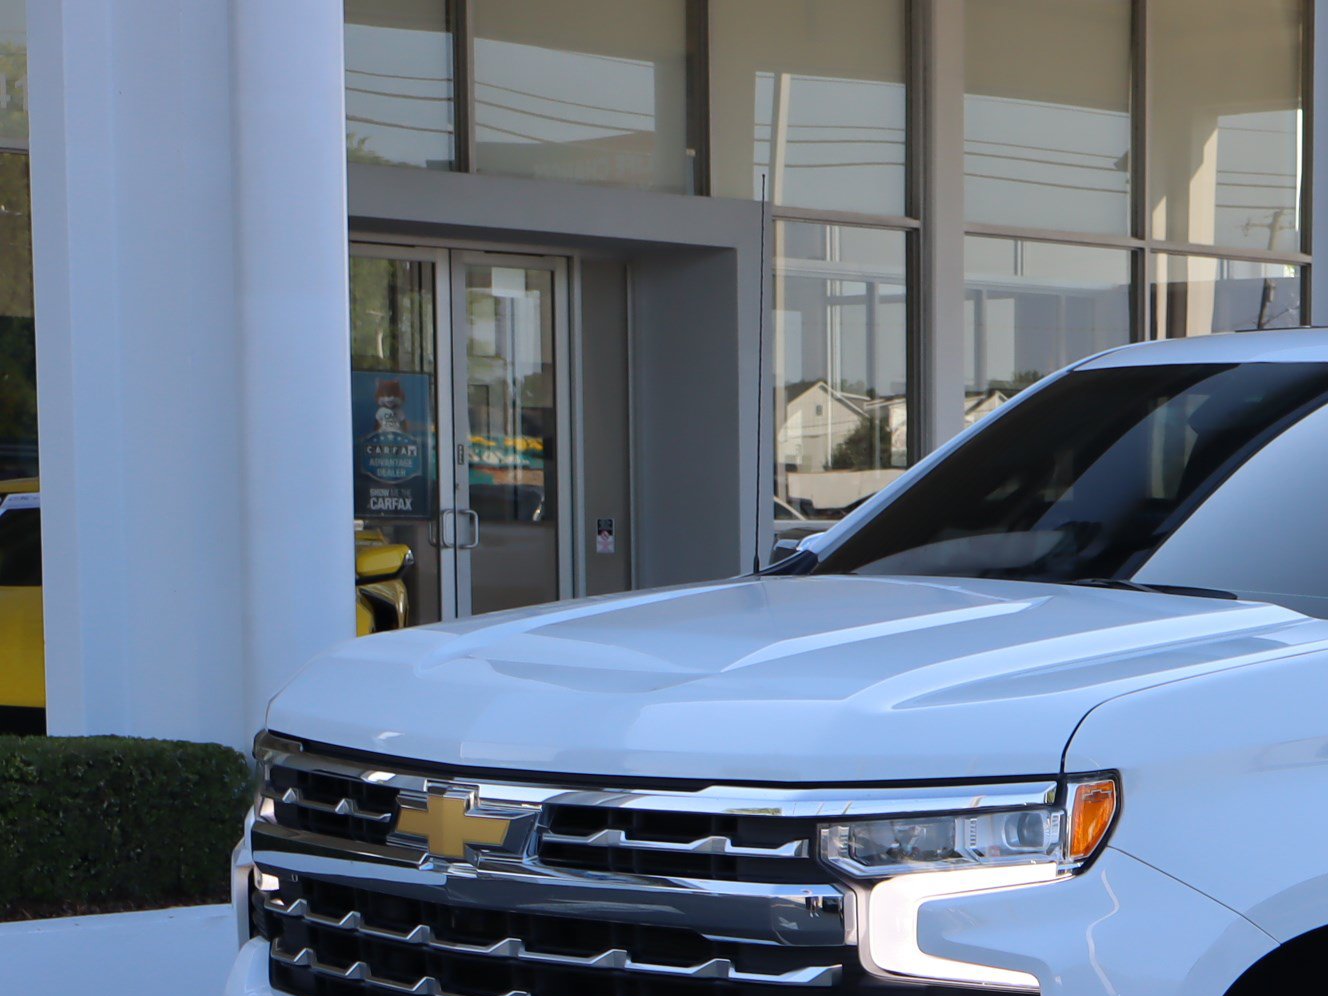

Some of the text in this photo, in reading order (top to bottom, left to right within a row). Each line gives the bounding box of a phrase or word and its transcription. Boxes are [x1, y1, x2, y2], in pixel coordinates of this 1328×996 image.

[366, 445, 417, 456] CARFAX
[369, 458, 413, 467] ADVANTAGE
[376, 468, 406, 477] DEALER
[369, 488, 389, 497] SHOW
[370, 498, 413, 511] CARFAX
